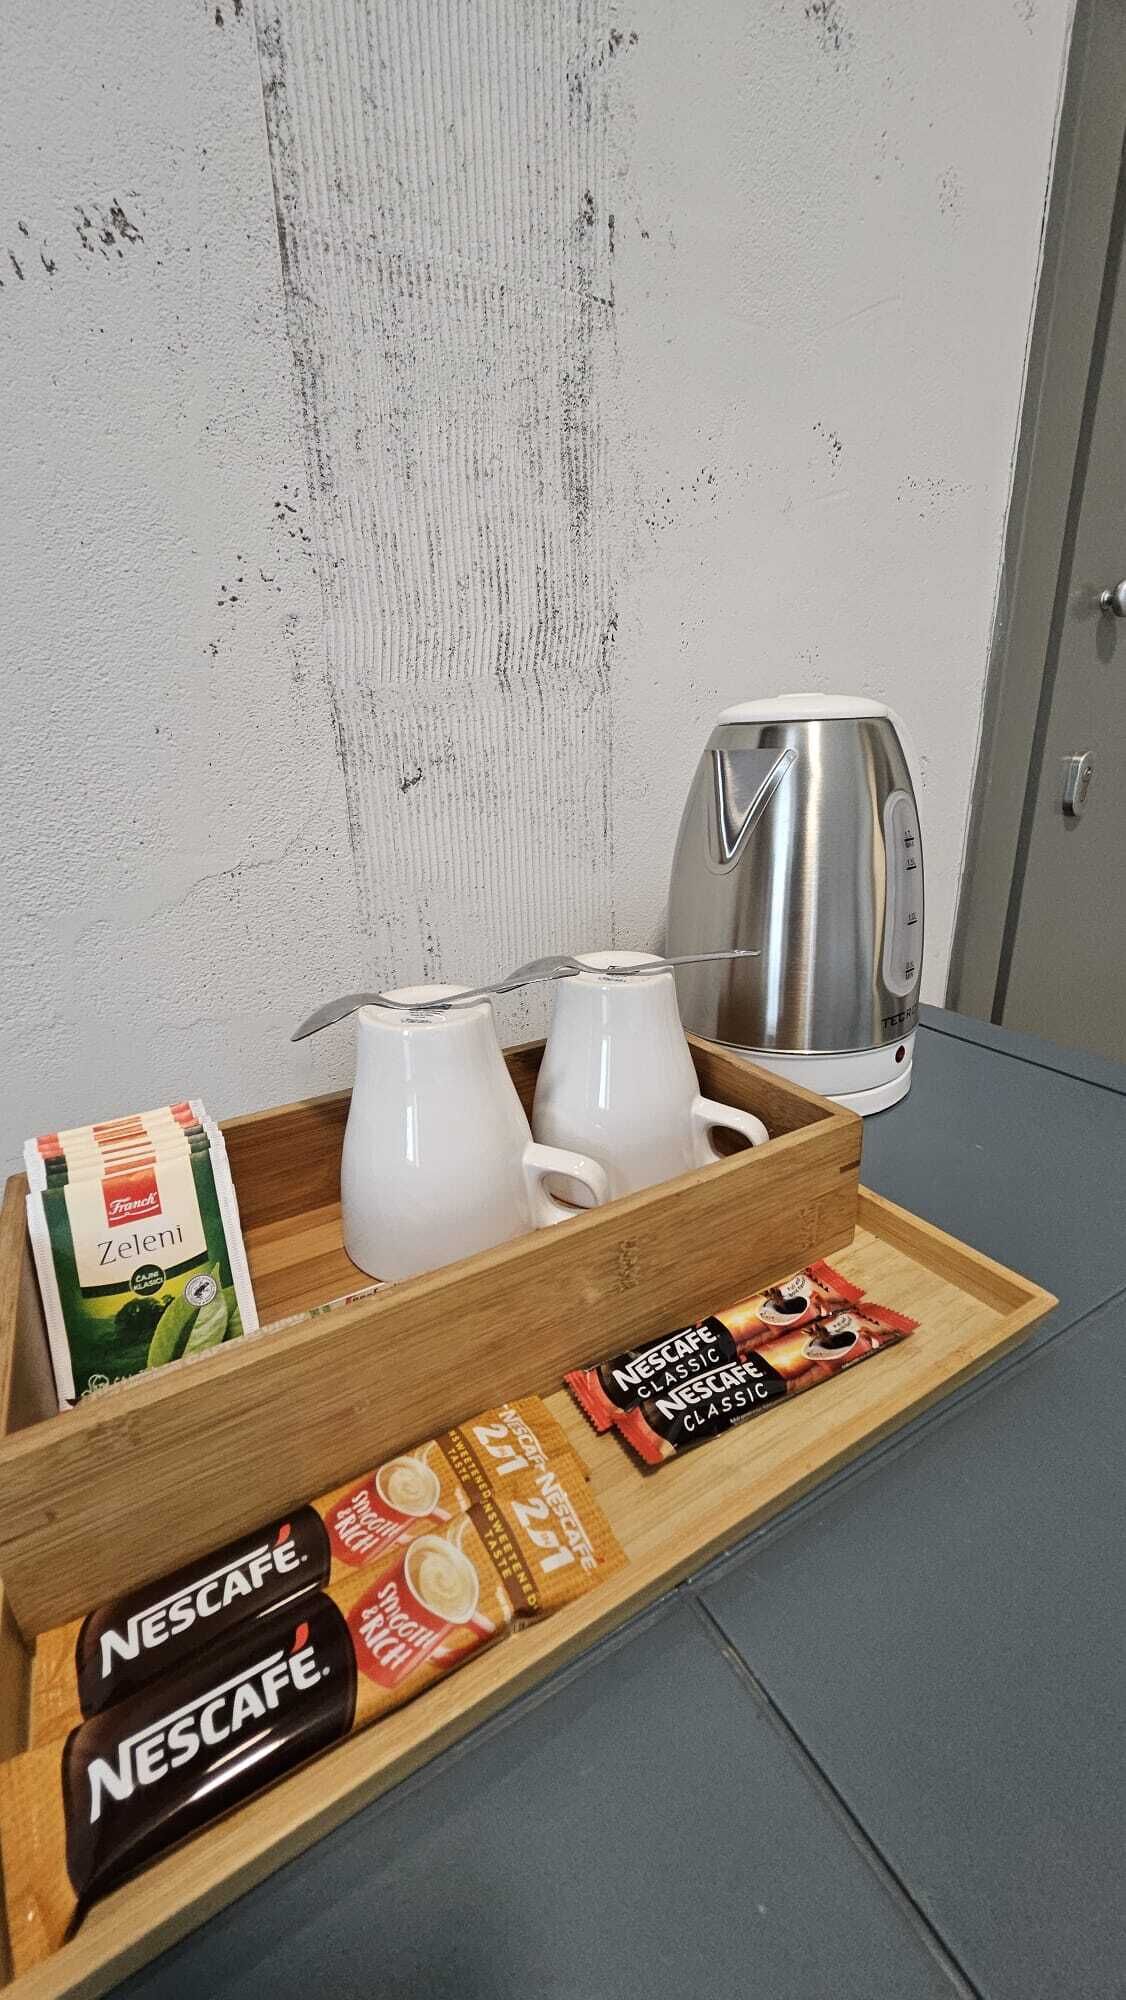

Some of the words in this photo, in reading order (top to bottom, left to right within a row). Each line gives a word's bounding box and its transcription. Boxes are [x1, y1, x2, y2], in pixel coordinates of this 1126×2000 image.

[109, 1192, 158, 1215] Franck
[97, 1225, 183, 1266] Zeleni
[637, 1348, 720, 1399] CLASSIC
[683, 1383, 768, 1432] CLASSIC
[498, 1408, 548, 1472] NESCAF
[447, 1448, 471, 1482] TASTE
[484, 1529, 512, 1579] TASTE
[377, 1581, 439, 1650] SMOOTH
